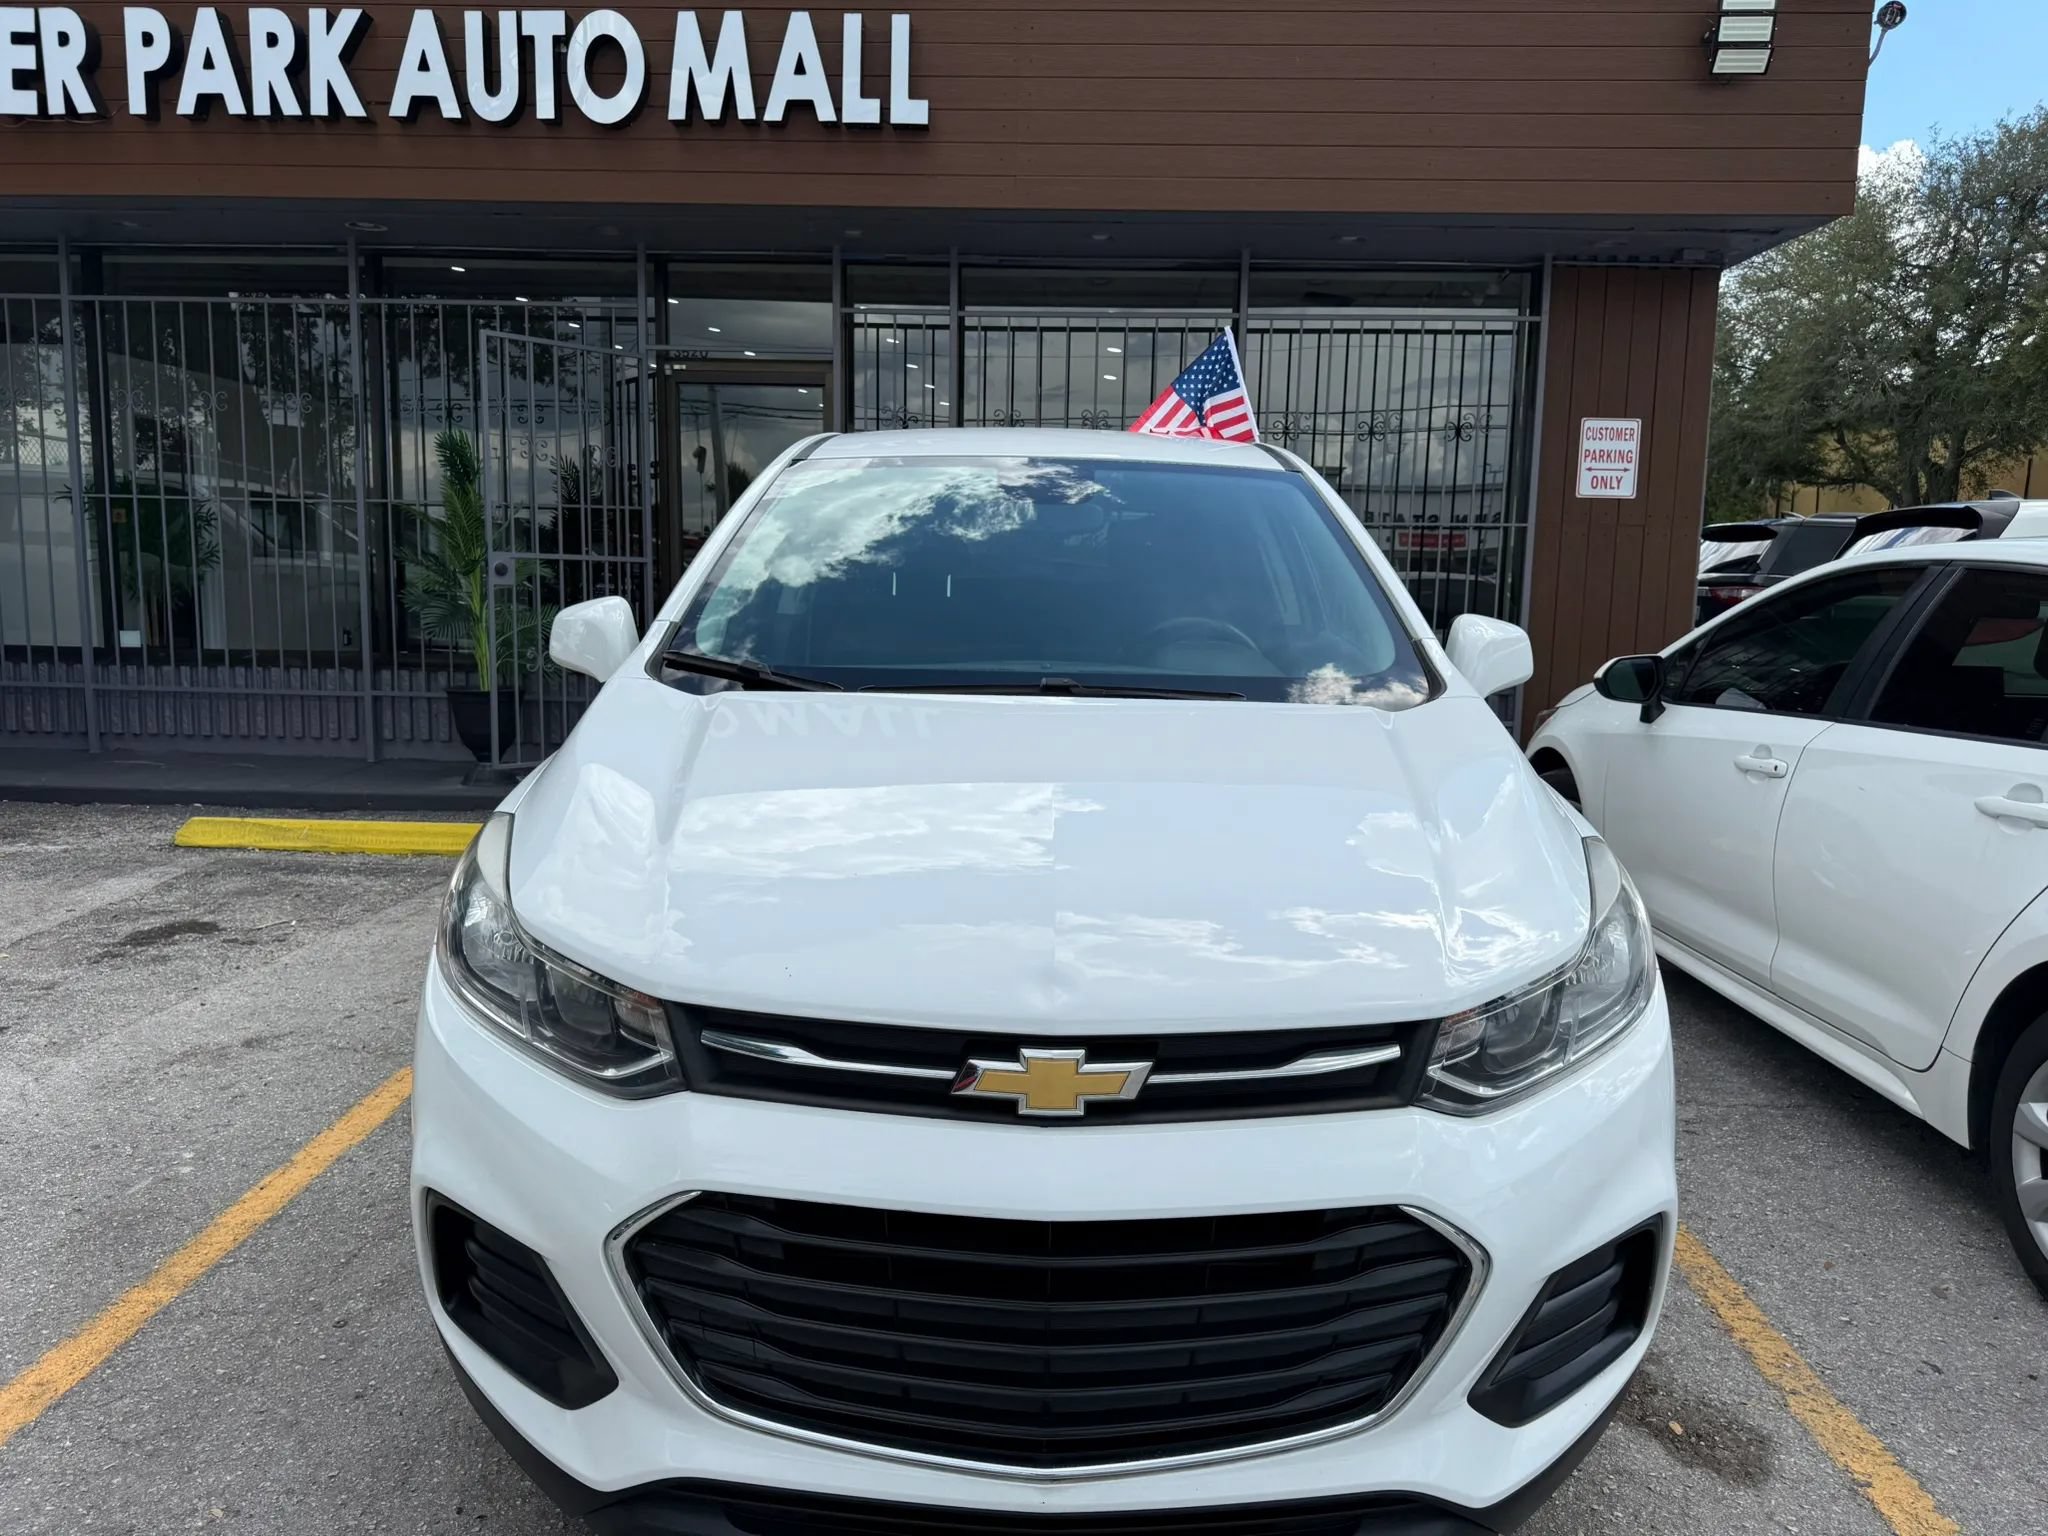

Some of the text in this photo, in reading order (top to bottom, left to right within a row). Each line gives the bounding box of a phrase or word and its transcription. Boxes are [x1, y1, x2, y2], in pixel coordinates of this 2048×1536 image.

[0, 6, 929, 125] ER PARK AUTO MALL
[1585, 426, 1635, 441] CUSTOMER
[1583, 449, 1633, 464] PARKING
[1590, 475, 1624, 490] ONLY
